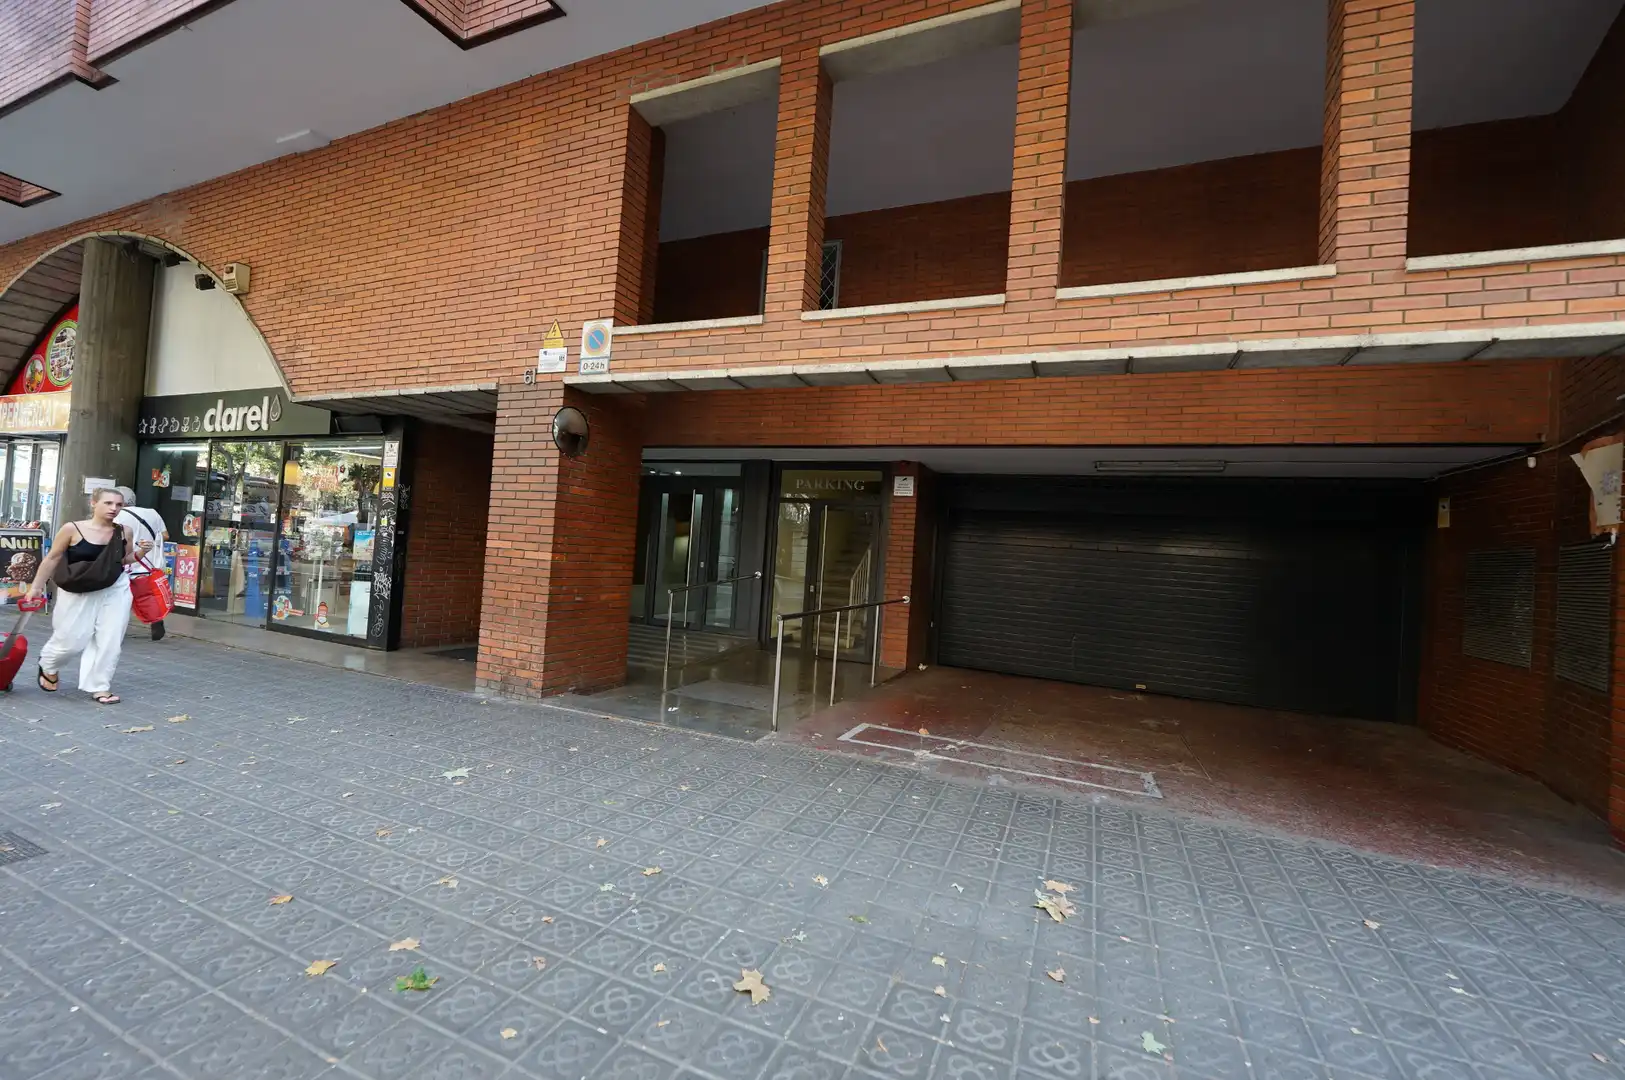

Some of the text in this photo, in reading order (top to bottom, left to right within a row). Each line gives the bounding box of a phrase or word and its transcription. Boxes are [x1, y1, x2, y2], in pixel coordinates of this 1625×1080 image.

[203, 396, 270, 432] clarel
[795, 477, 865, 491] PARKING
[0, 537, 39, 549] Nuii
